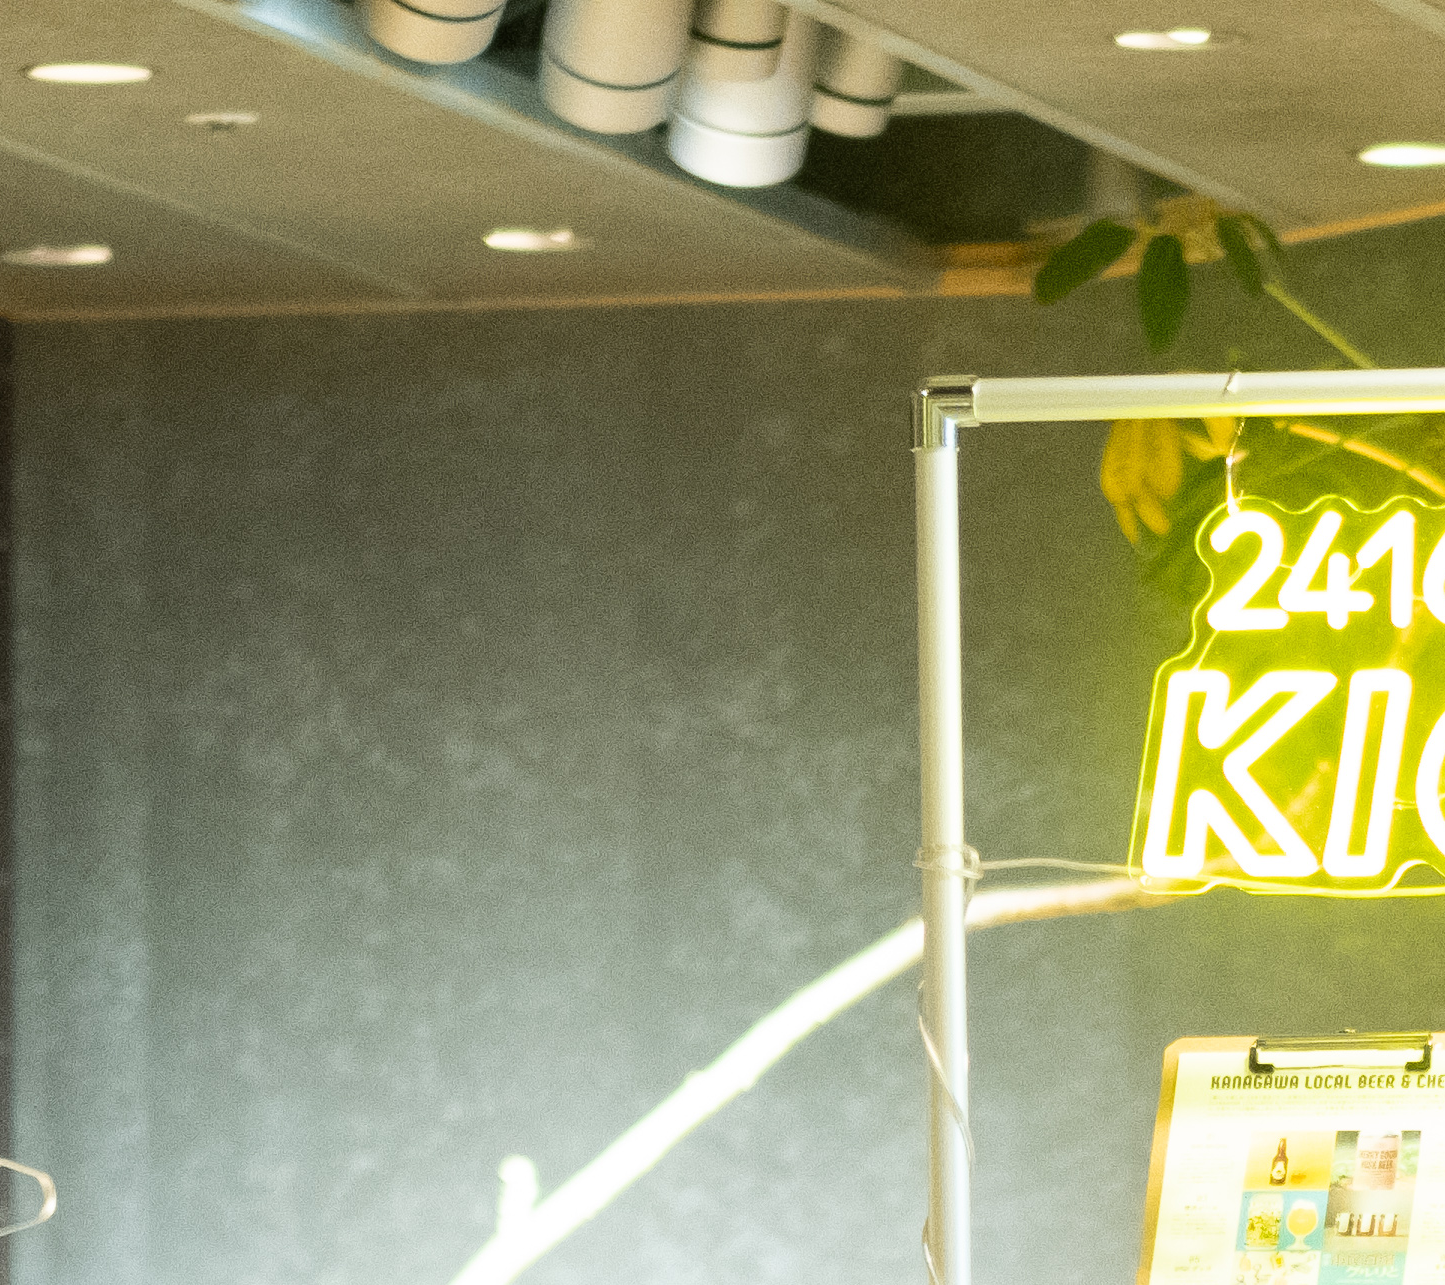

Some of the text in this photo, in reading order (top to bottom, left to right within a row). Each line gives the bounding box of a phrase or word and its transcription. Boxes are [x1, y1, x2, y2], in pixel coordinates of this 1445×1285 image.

[1211, 1076, 1299, 1090] KANAGAWA
[1305, 1075, 1352, 1090] LOCAL
[1358, 1074, 1395, 1089] BEER
